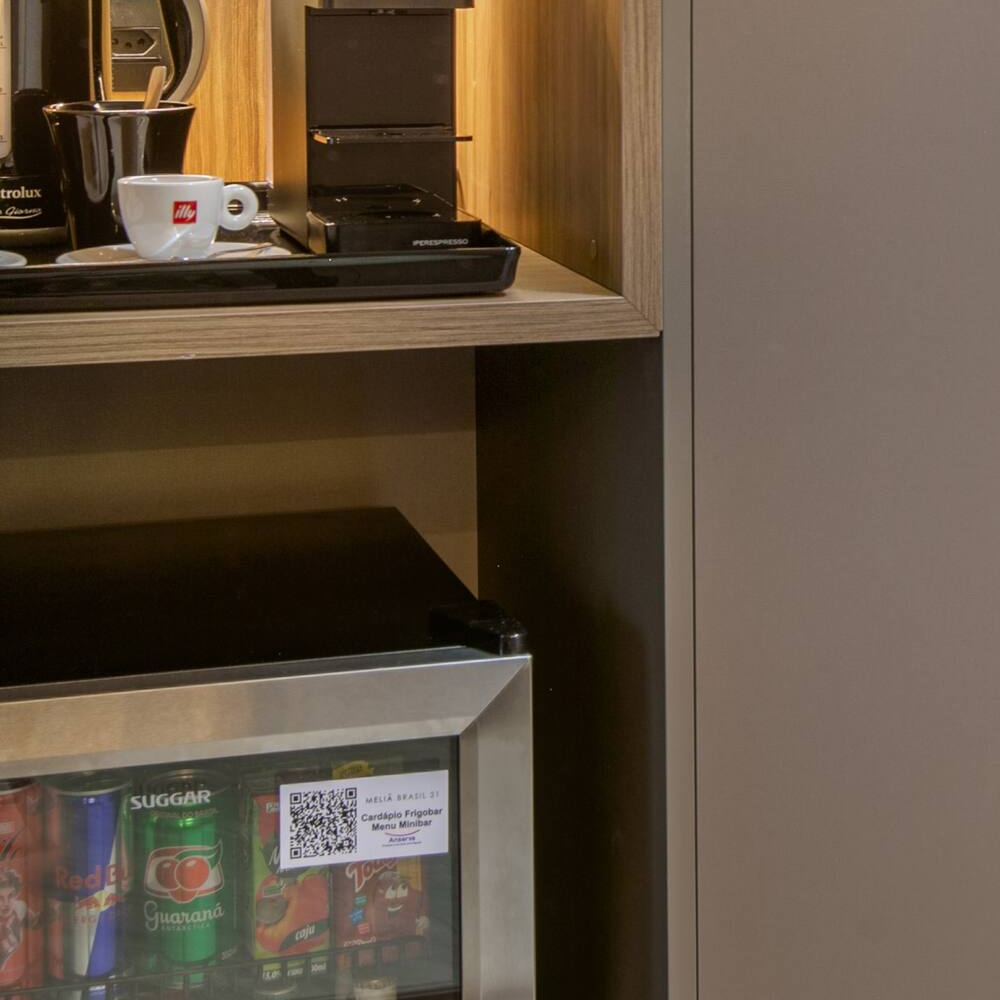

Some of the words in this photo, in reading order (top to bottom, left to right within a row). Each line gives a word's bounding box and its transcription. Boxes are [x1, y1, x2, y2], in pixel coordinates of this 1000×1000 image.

[175, 204, 195, 222] illy
[130, 790, 211, 810] SUGGAR
[397, 791, 427, 801] BRASIL
[361, 810, 403, 822] Cardápio
[404, 808, 443, 819] Frigobar
[372, 822, 397, 832] Menu
[399, 819, 432, 829] Minibar
[144, 900, 225, 932] Guaraná
